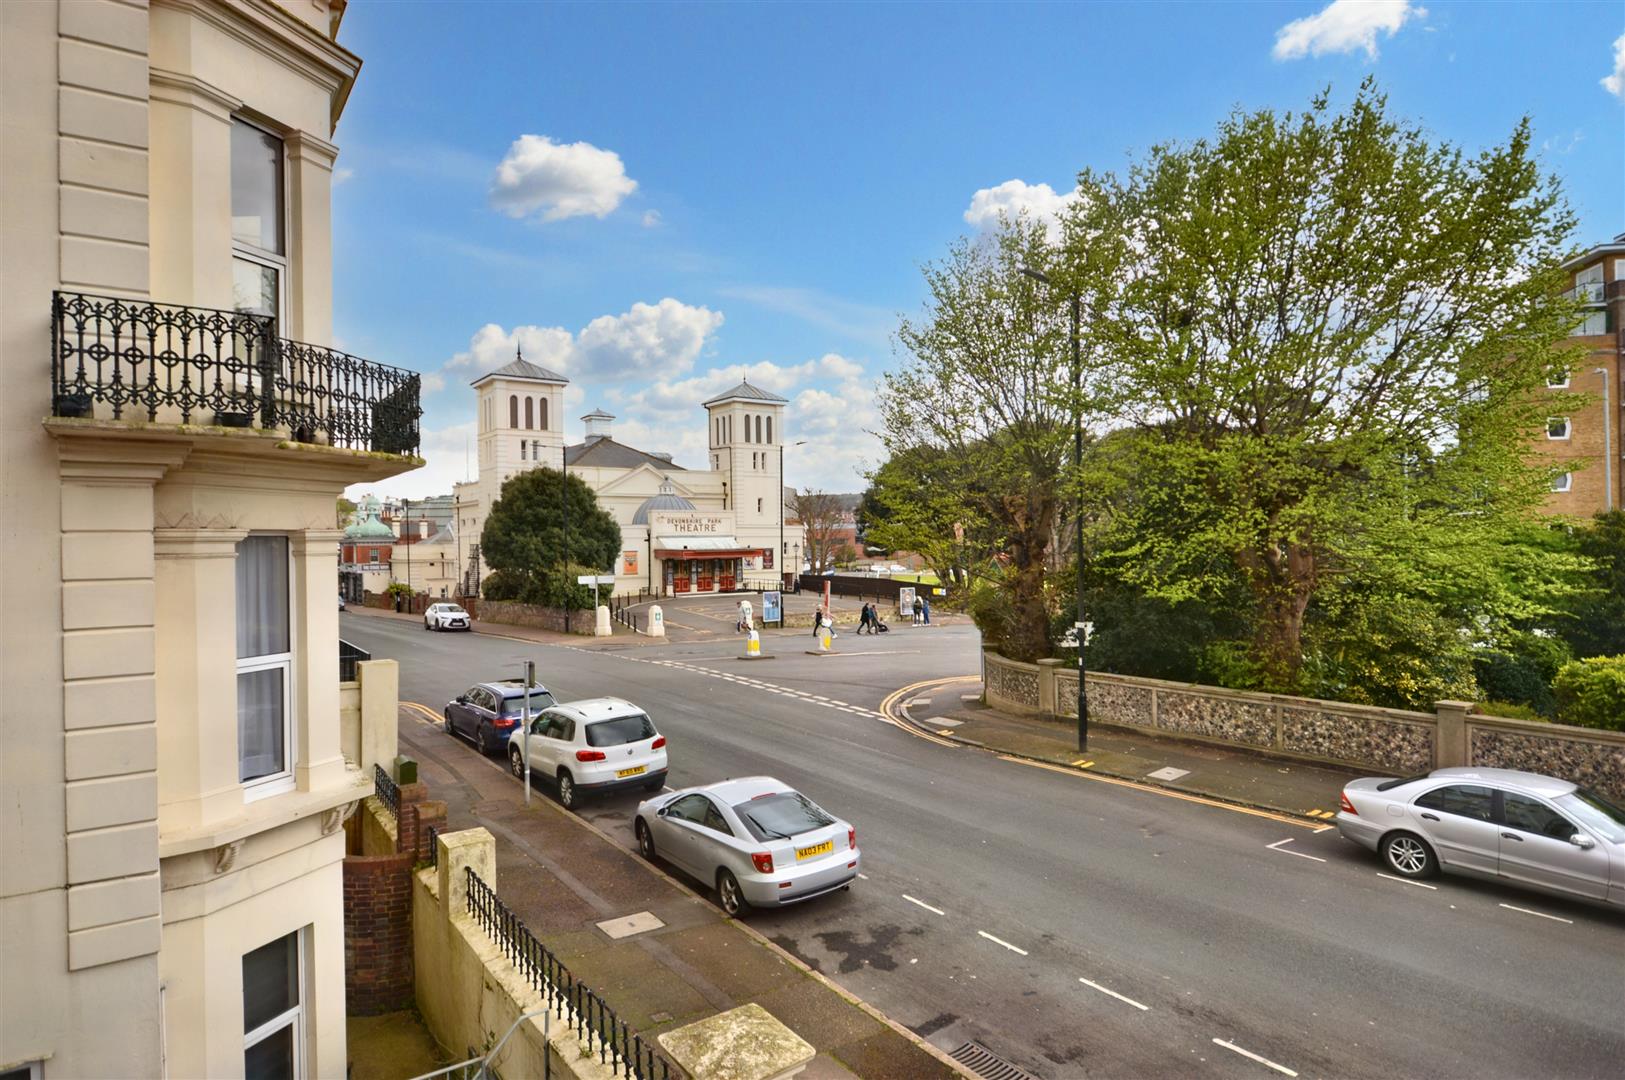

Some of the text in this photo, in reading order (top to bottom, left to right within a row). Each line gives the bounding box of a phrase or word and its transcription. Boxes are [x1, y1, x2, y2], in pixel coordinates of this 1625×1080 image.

[674, 523, 717, 532] THEATRE
[798, 841, 830, 857] NA03 FRT
